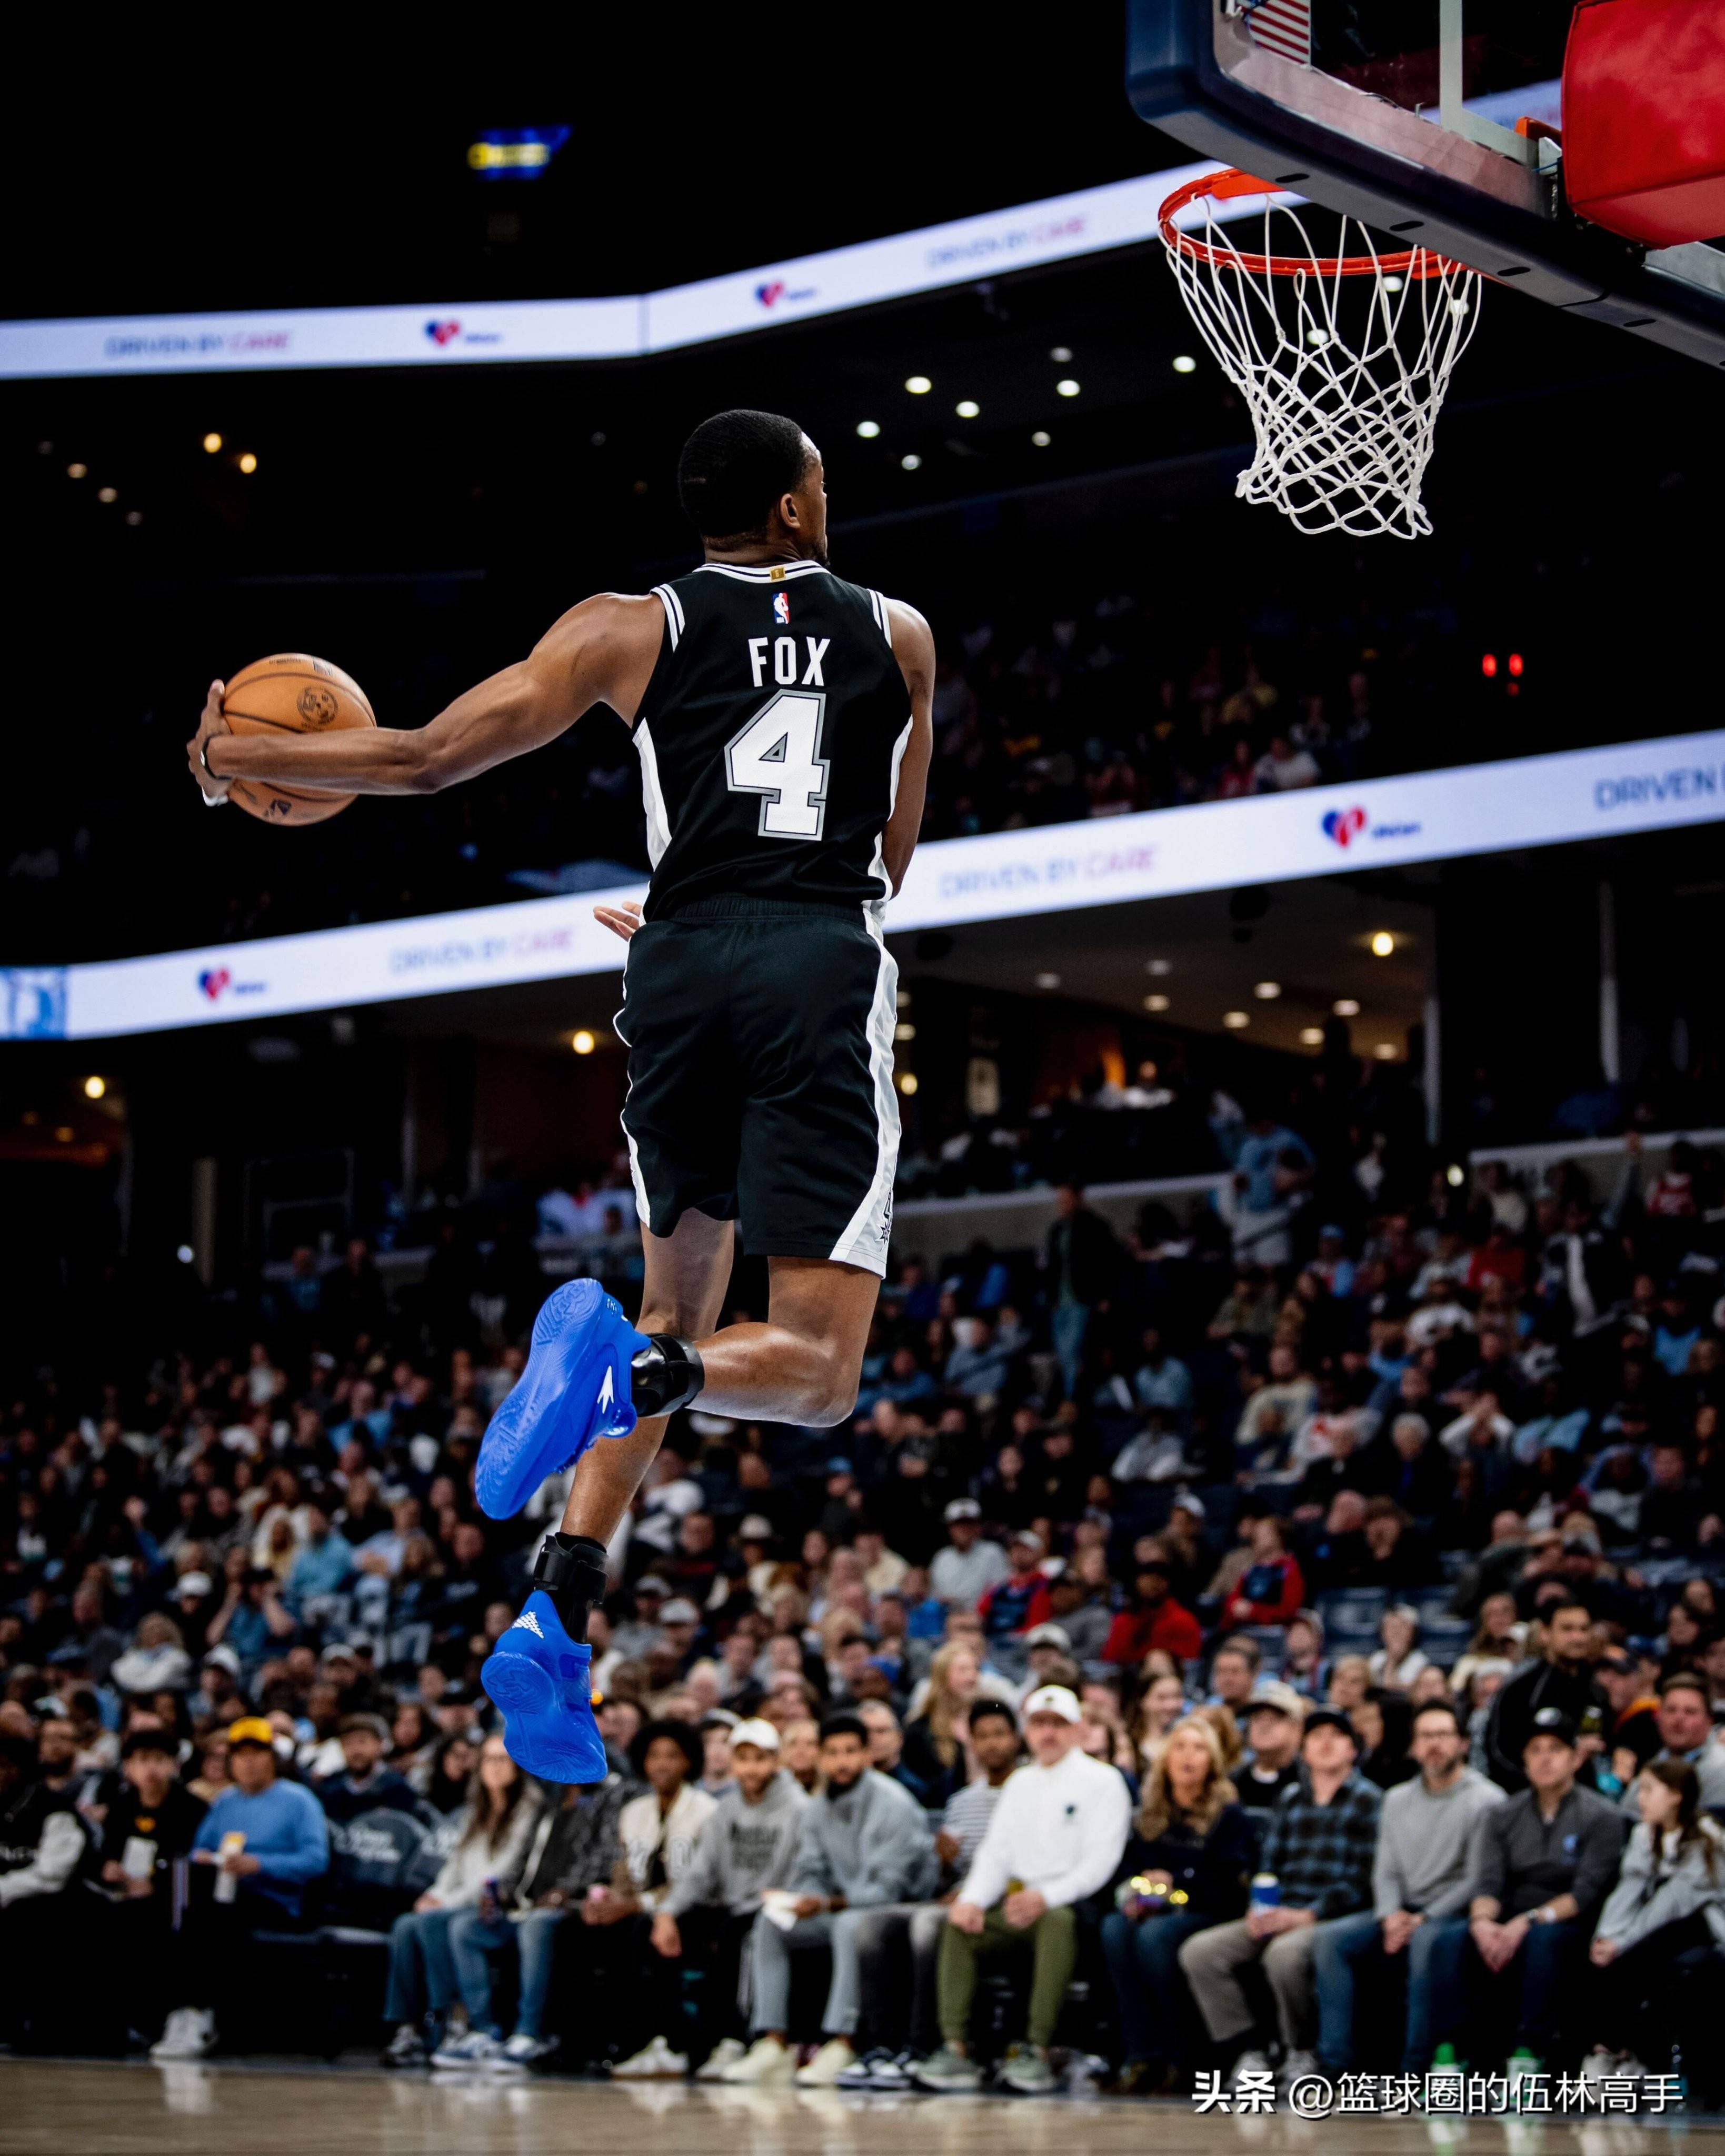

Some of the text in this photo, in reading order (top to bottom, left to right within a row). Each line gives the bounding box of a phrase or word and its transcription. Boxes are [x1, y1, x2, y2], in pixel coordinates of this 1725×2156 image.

[748, 636, 830, 687] FOX
[724, 689, 830, 841] 4
[1594, 767, 1717, 811] DRIVEN
[940, 862, 1040, 898] DRIVEN
[1046, 856, 1077, 884] BY
